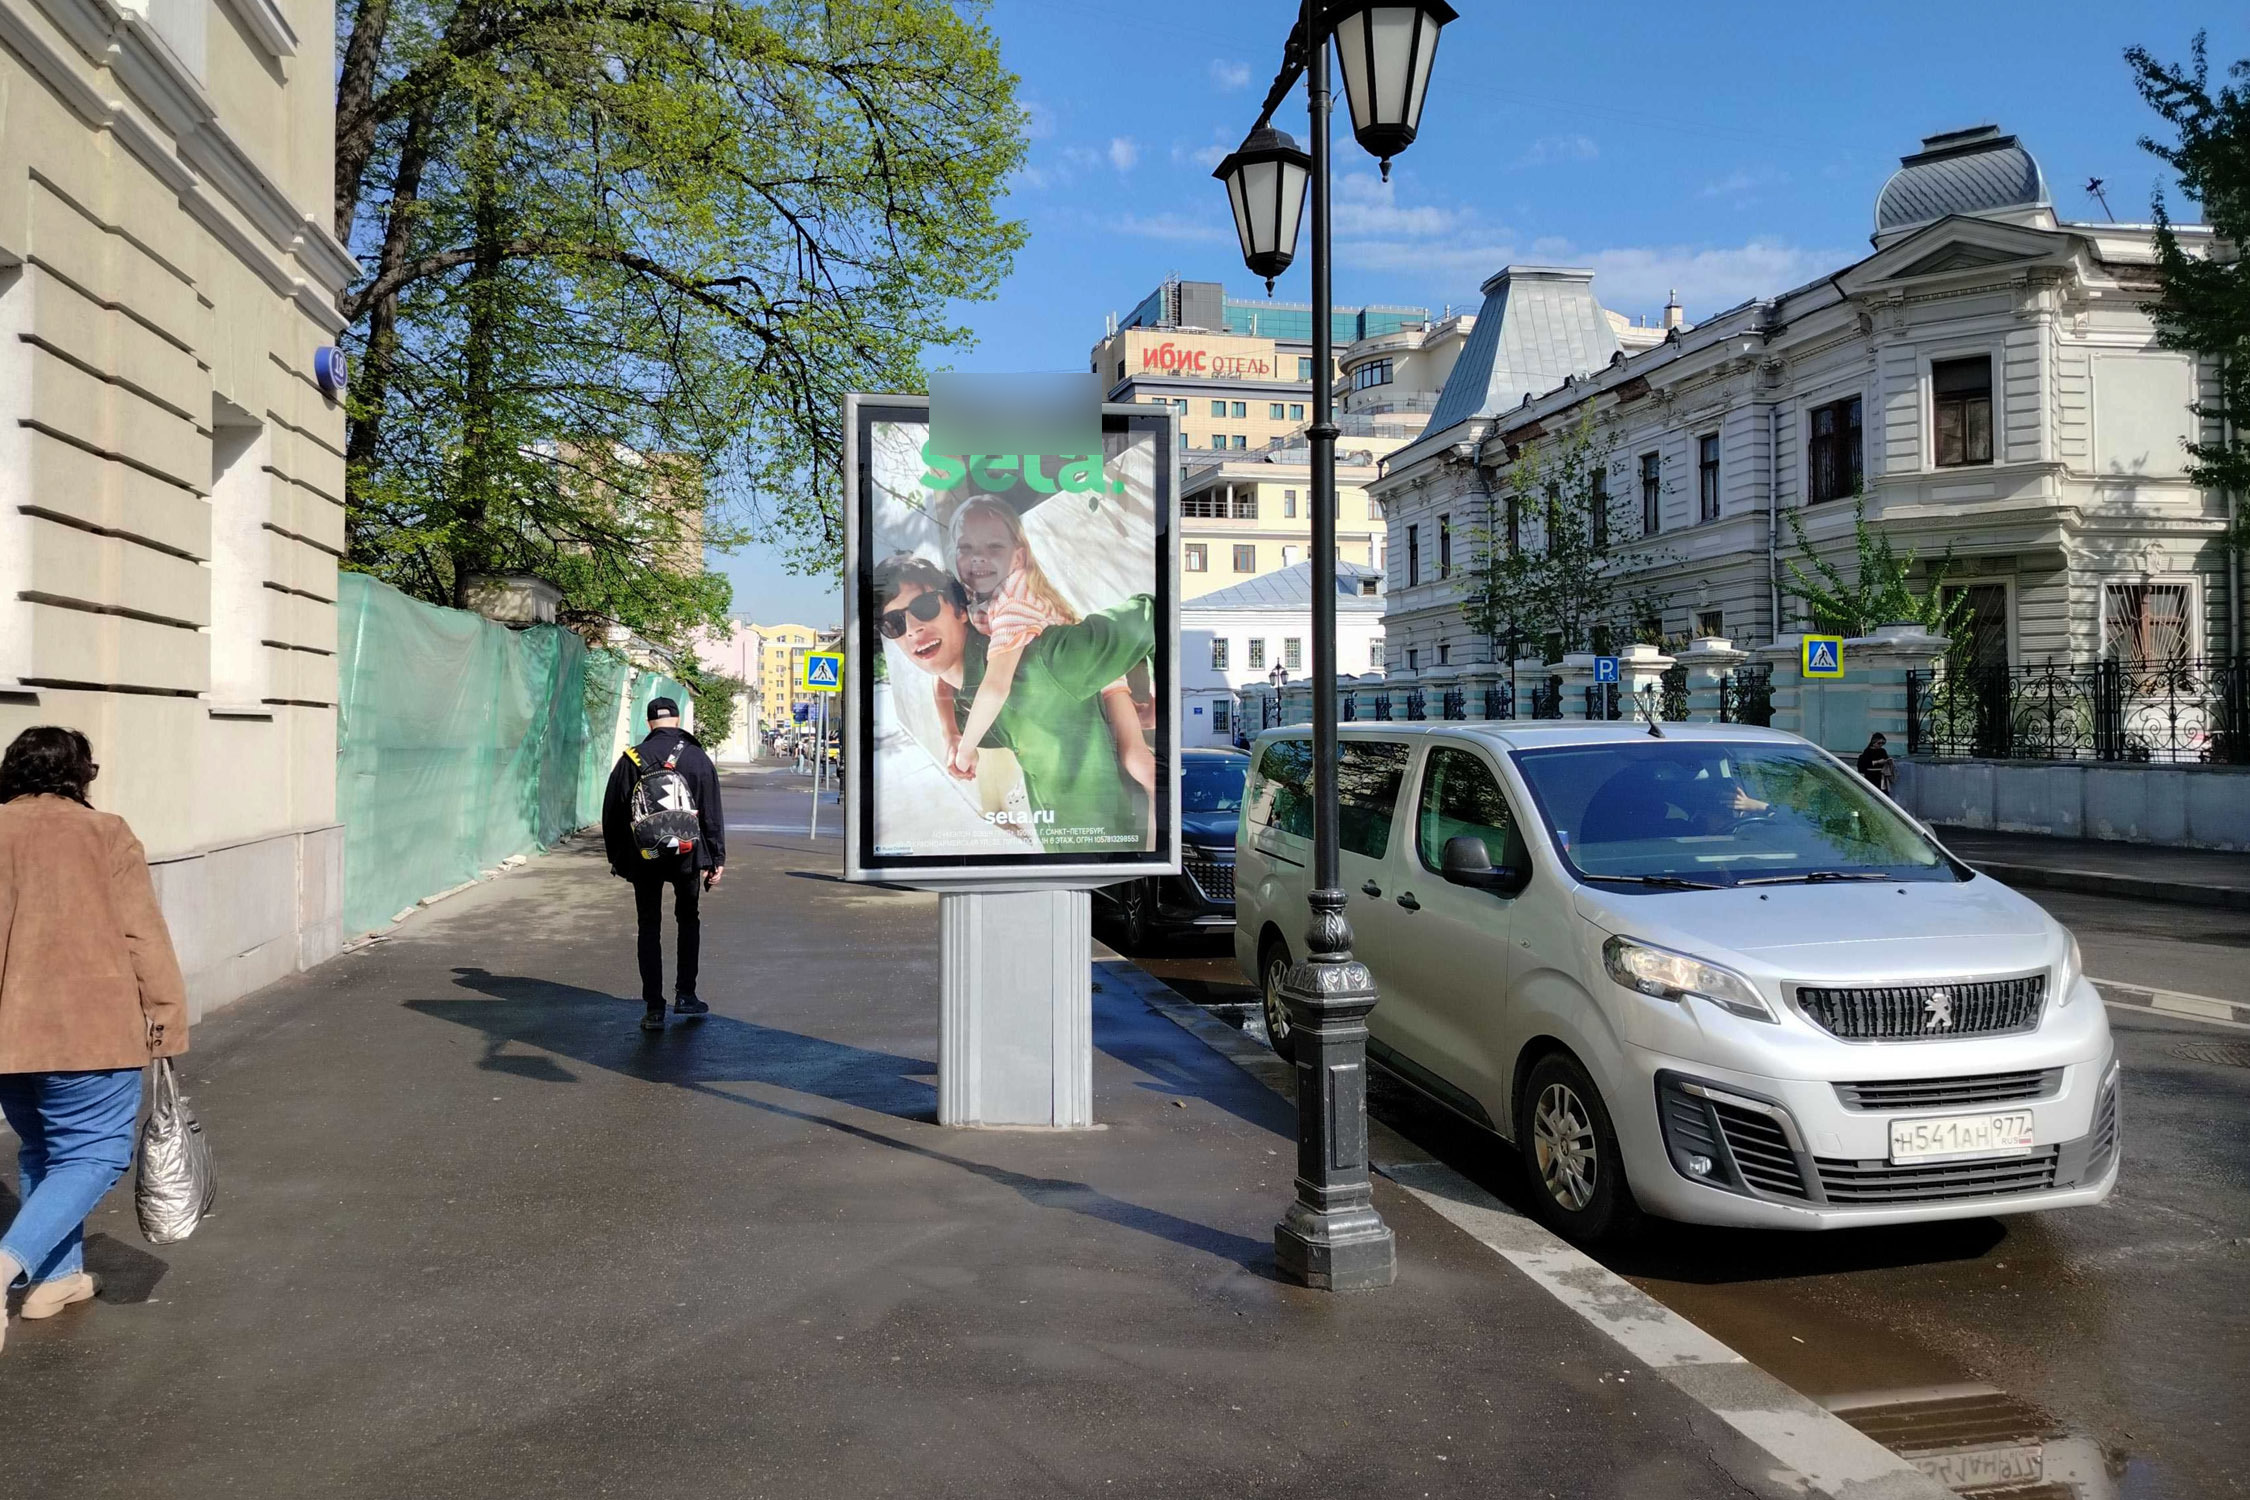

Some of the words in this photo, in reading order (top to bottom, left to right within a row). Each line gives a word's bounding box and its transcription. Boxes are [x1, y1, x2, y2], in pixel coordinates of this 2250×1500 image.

[334, 353, 345, 378] 18
[1212, 356, 1270, 374] ОТЕЛЬ
[1599, 659, 1614, 680] P
[984, 810, 1055, 825] sela.ru
[1045, 826, 1106, 836] САНКТ-ПЕТЕРБУРГ,
[1076, 836, 1092, 844] ОГРН
[1992, 1116, 2025, 1138] 977
[2001, 1136, 2019, 1145] RUS
